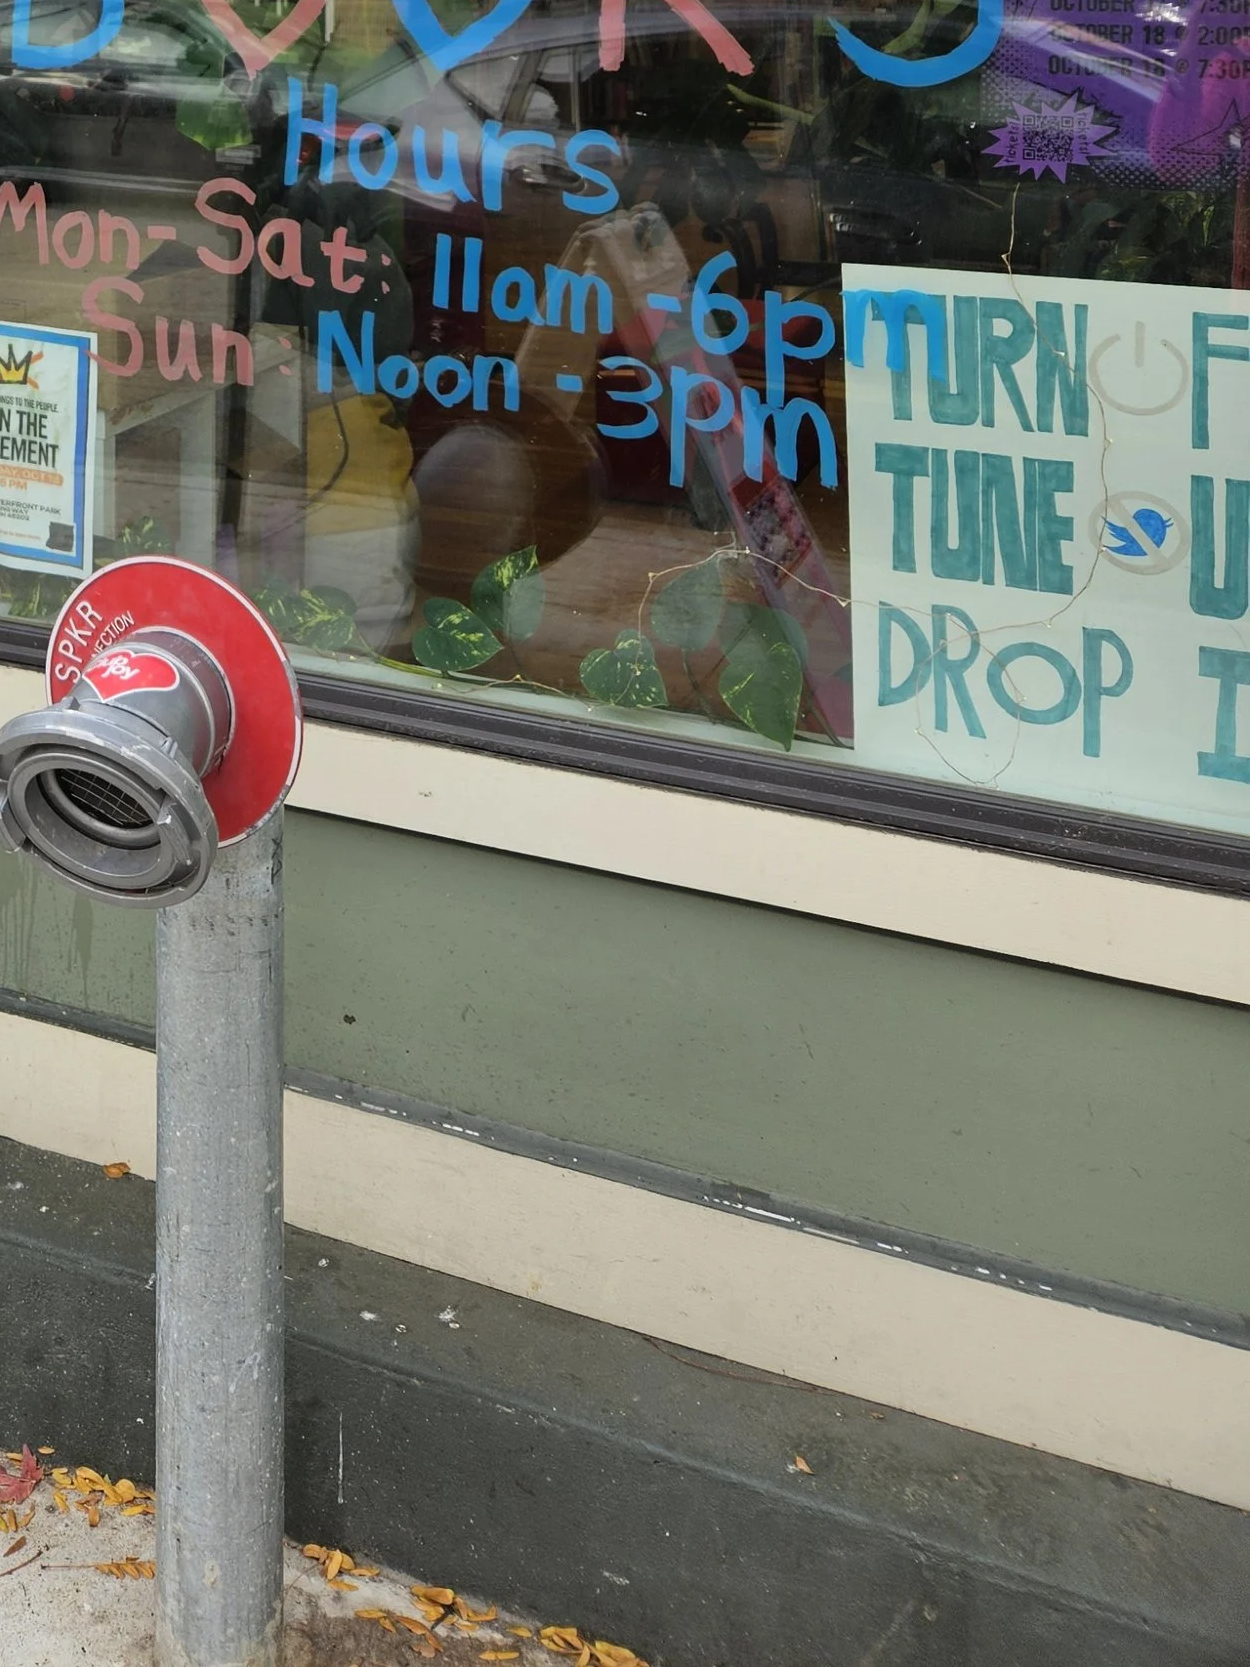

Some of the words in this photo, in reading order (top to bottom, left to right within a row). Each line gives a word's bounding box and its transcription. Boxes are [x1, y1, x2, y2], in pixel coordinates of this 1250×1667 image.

[282, 76, 621, 215] Hours
[432, 233, 613, 335] 11am
[316, 309, 520, 413] Noon
[871, 290, 1090, 437] TURN
[16, 397, 23, 406] TO
[24, 398, 35, 409] THE
[36, 400, 59, 413] PEOPLE.
[16, 410, 48, 439] THE
[8, 480, 28, 490] PM
[12, 506, 29, 515] WAY
[24, 470, 45, 480] OCT
[40, 505, 61, 515] PARK
[874, 441, 1075, 596] TUNE
[54, 599, 103, 684] SPKR
[877, 600, 1135, 759] DROP
